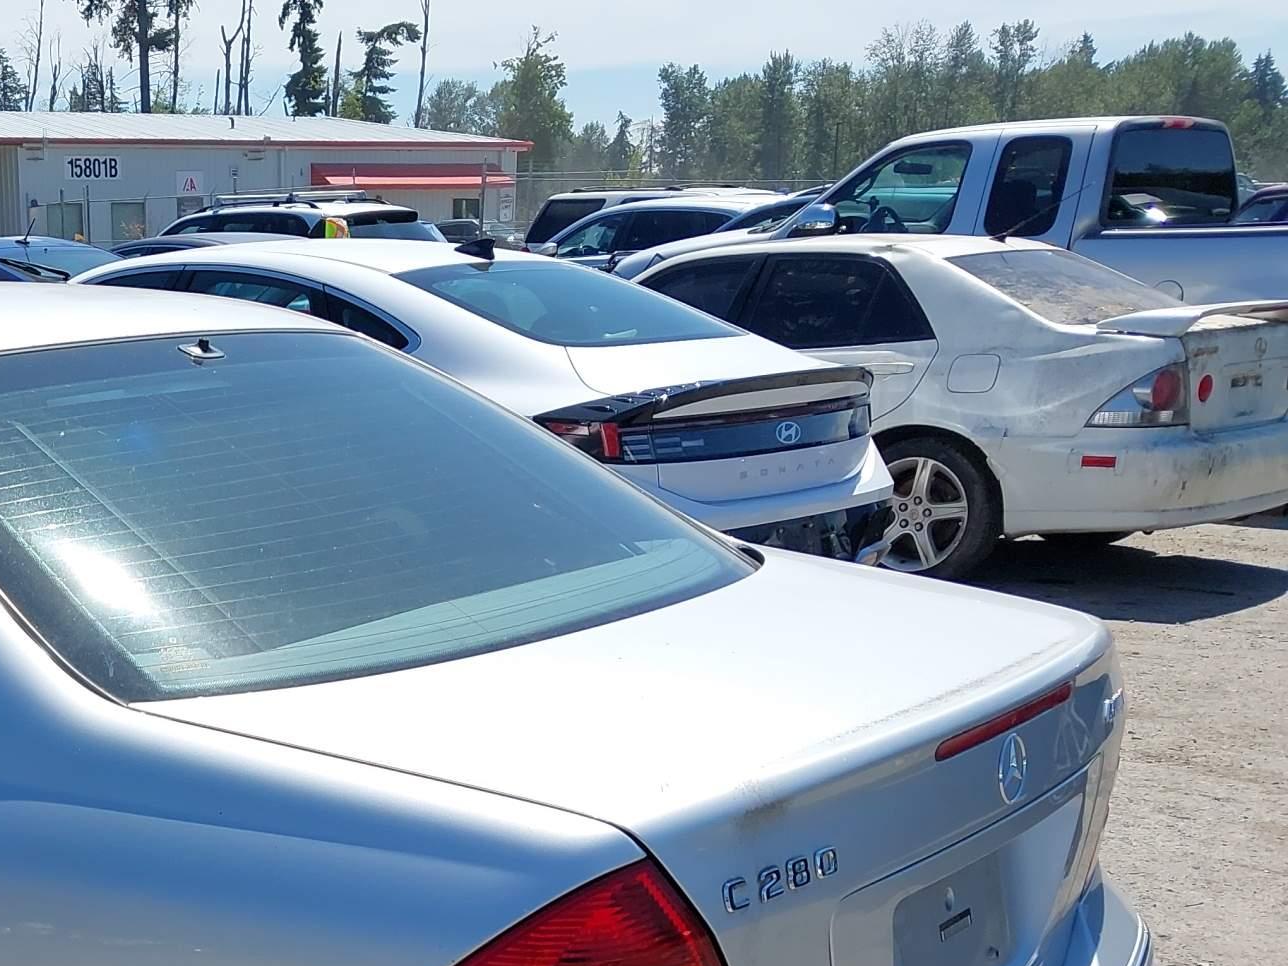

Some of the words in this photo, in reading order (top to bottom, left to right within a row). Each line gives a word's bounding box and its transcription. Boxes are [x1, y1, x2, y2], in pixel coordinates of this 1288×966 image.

[67, 158, 118, 178] 15801B
[739, 458, 835, 479] SONATA
[722, 877, 751, 913] C
[758, 846, 839, 904] 280
